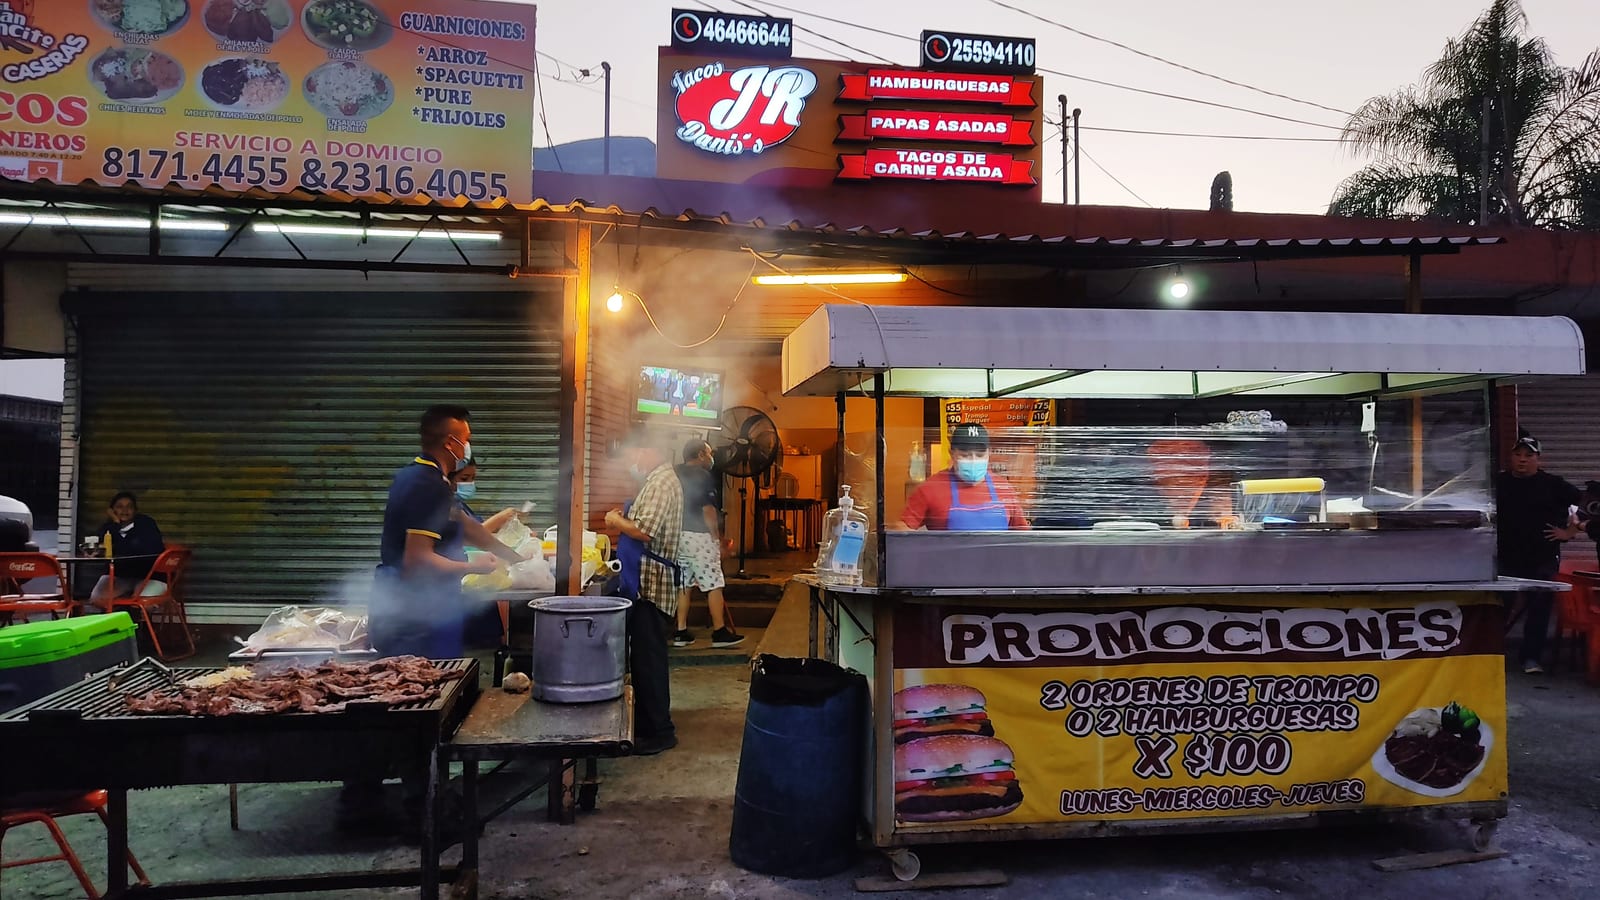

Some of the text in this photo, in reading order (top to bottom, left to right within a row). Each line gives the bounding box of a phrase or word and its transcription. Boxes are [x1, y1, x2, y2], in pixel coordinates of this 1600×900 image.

[400, 12, 525, 40] GUARNICIONES:
[703, 17, 791, 47] 46466644
[3, 34, 88, 82] CASERAS
[671, 61, 724, 95] Tacos
[869, 76, 1010, 94] HAMBURGUESAS
[709, 65, 818, 130] JR
[871, 117, 1008, 133] PAPAS ASADAS
[174, 131, 442, 164] SERVICIO A DOMICIO
[897, 151, 987, 165] TACOS DE
[102, 147, 288, 186] 8171.4455
[874, 163, 1003, 178] CARNE ASADA
[962, 404, 992, 412] Especial
[944, 604, 1463, 663] PROMOCIONES
[1041, 675, 1379, 709] 2 ORDENES DE TROMPO
[1096, 707, 1123, 735] 2
[1124, 703, 1359, 734] HAMBURGUESAS
[1133, 733, 1292, 778] X $100
